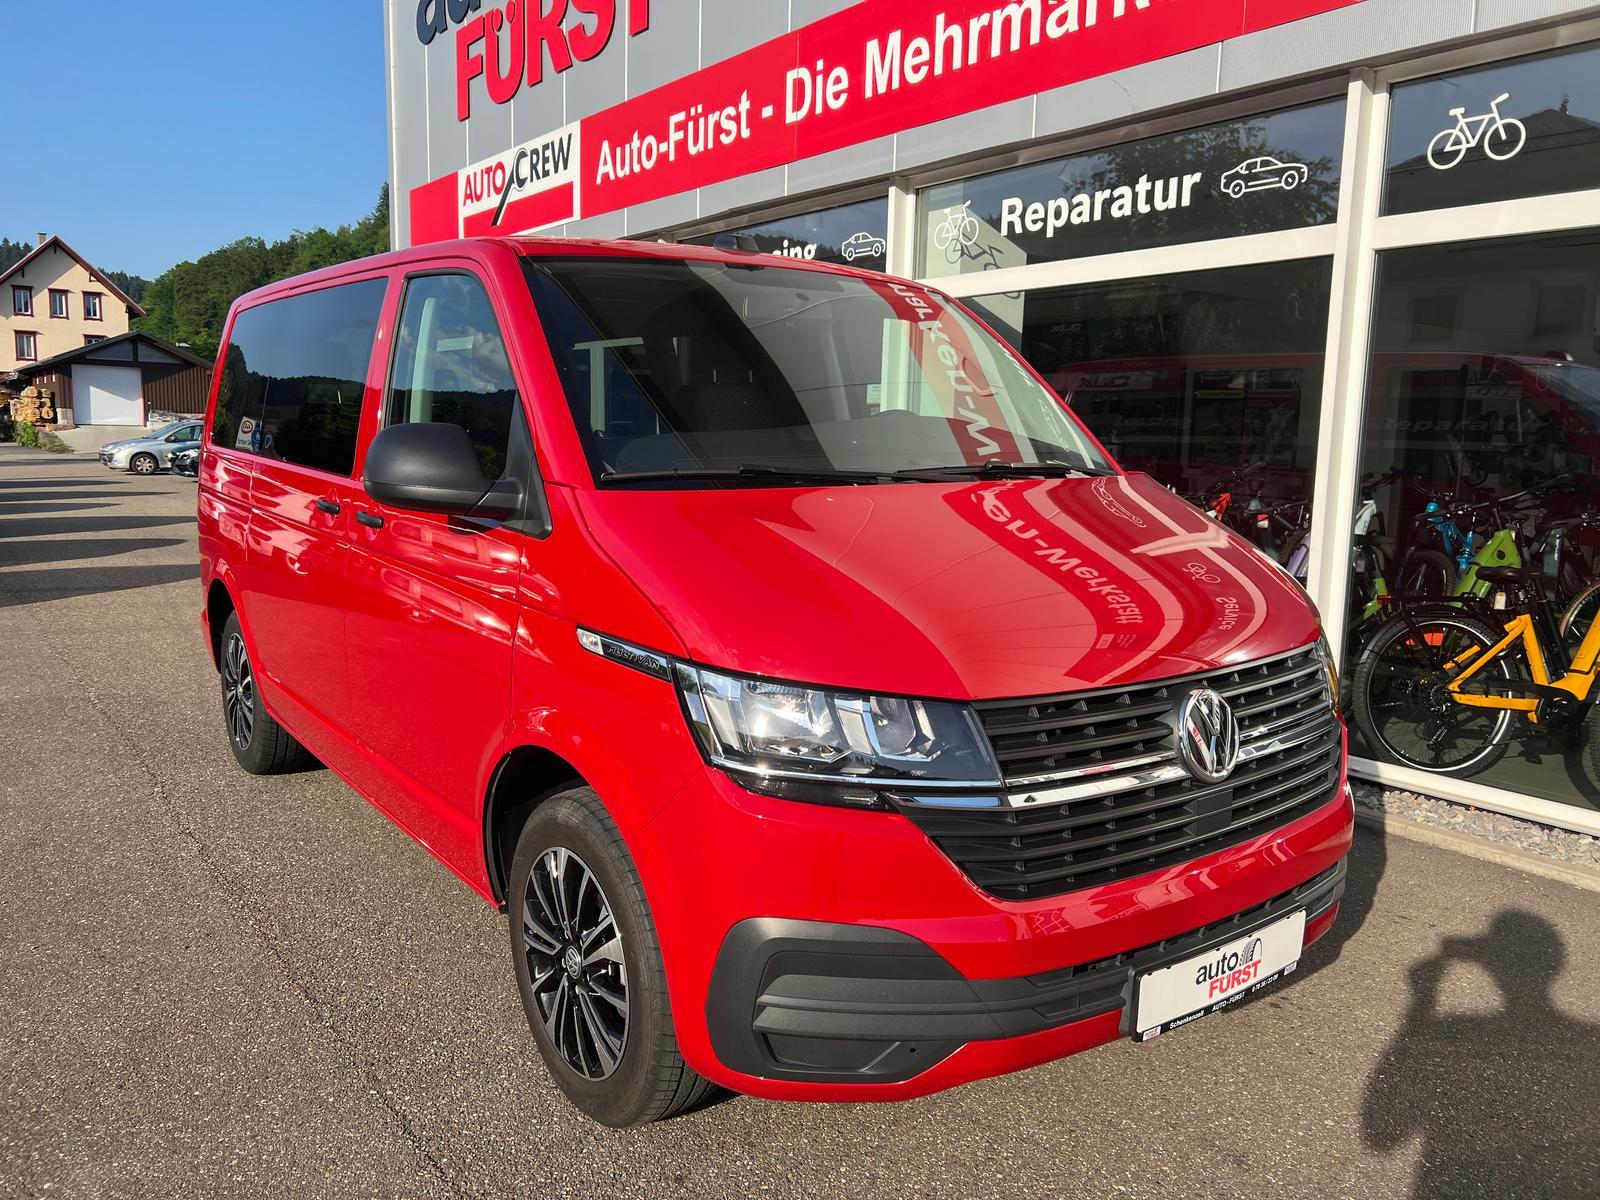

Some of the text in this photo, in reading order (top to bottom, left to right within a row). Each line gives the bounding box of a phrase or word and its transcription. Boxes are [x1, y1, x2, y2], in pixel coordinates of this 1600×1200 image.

[595, 89, 752, 185] Auto-Fürst
[785, 58, 849, 125] Die
[463, 132, 573, 207] AUTO CREW
[1000, 171, 1203, 238] Reparatur
[1195, 951, 1239, 985] auto
[1208, 960, 1262, 999] FÜRST
[1169, 1010, 1205, 1030] Schenkenzell
